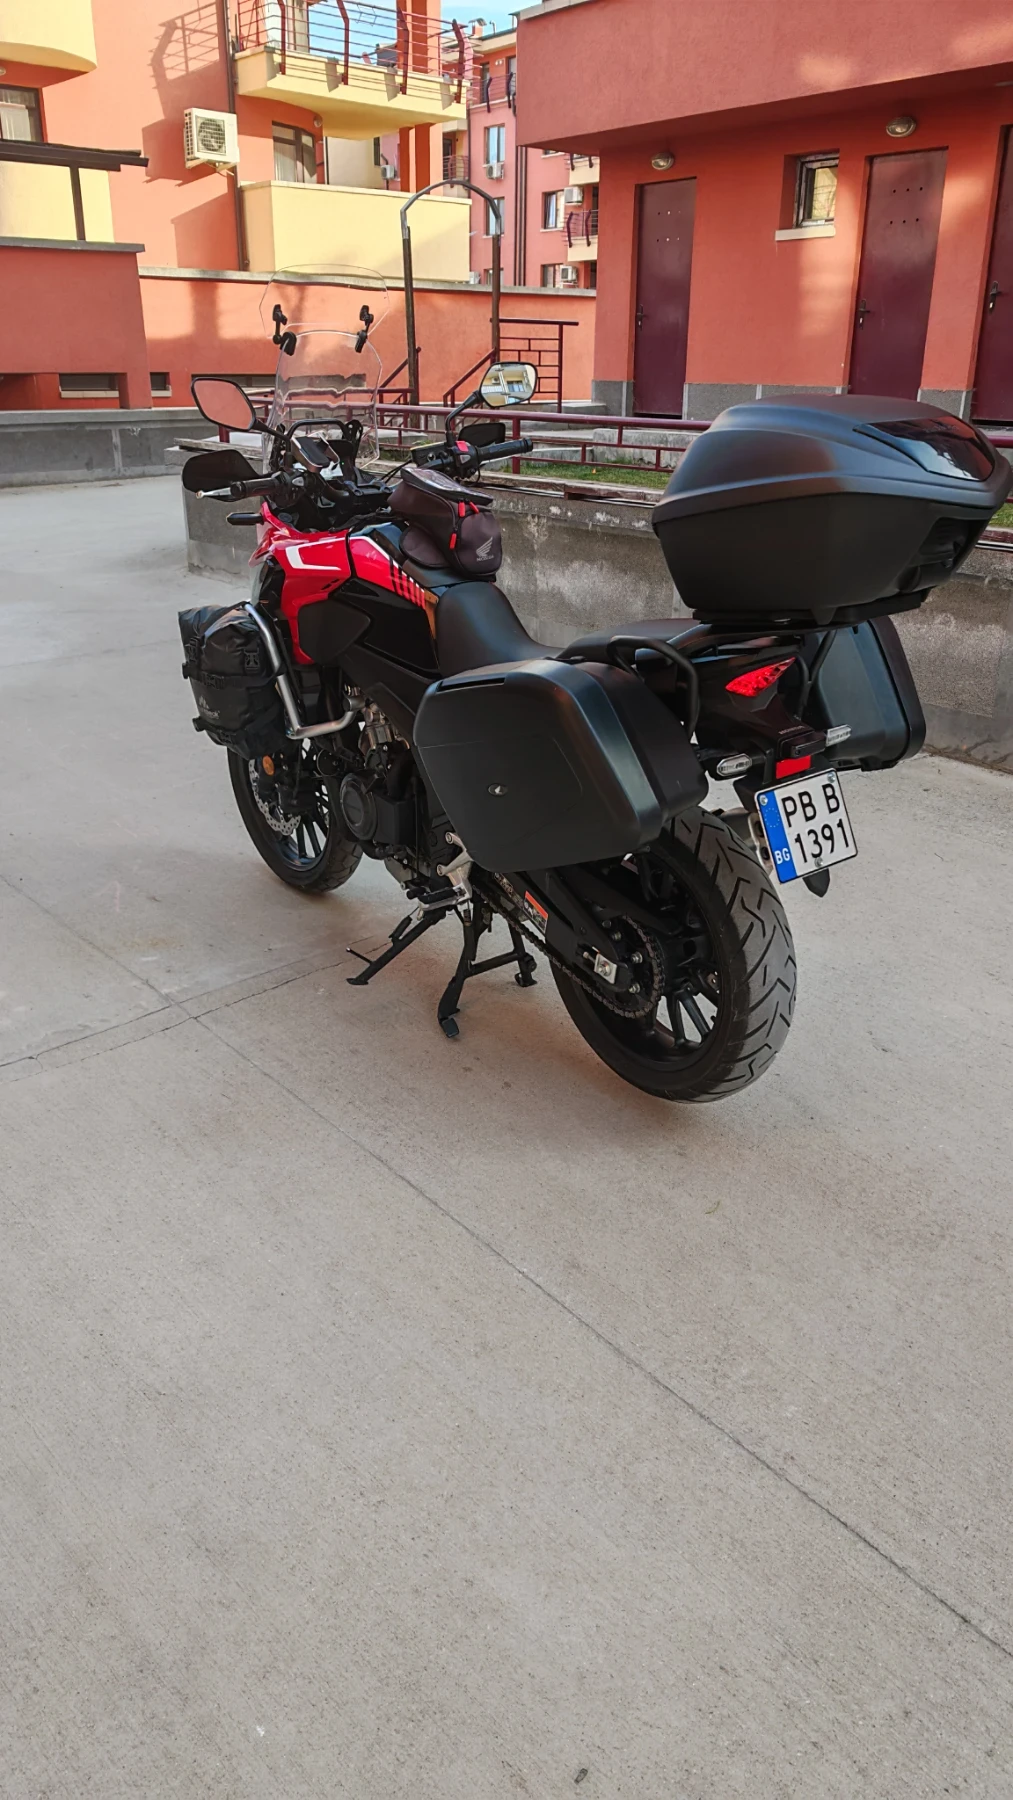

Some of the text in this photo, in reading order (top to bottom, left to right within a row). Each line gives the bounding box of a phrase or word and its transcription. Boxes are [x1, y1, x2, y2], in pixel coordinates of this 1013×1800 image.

[781, 783, 840, 828] PB B
[774, 847, 791, 864] BG
[794, 818, 849, 863] 1391
